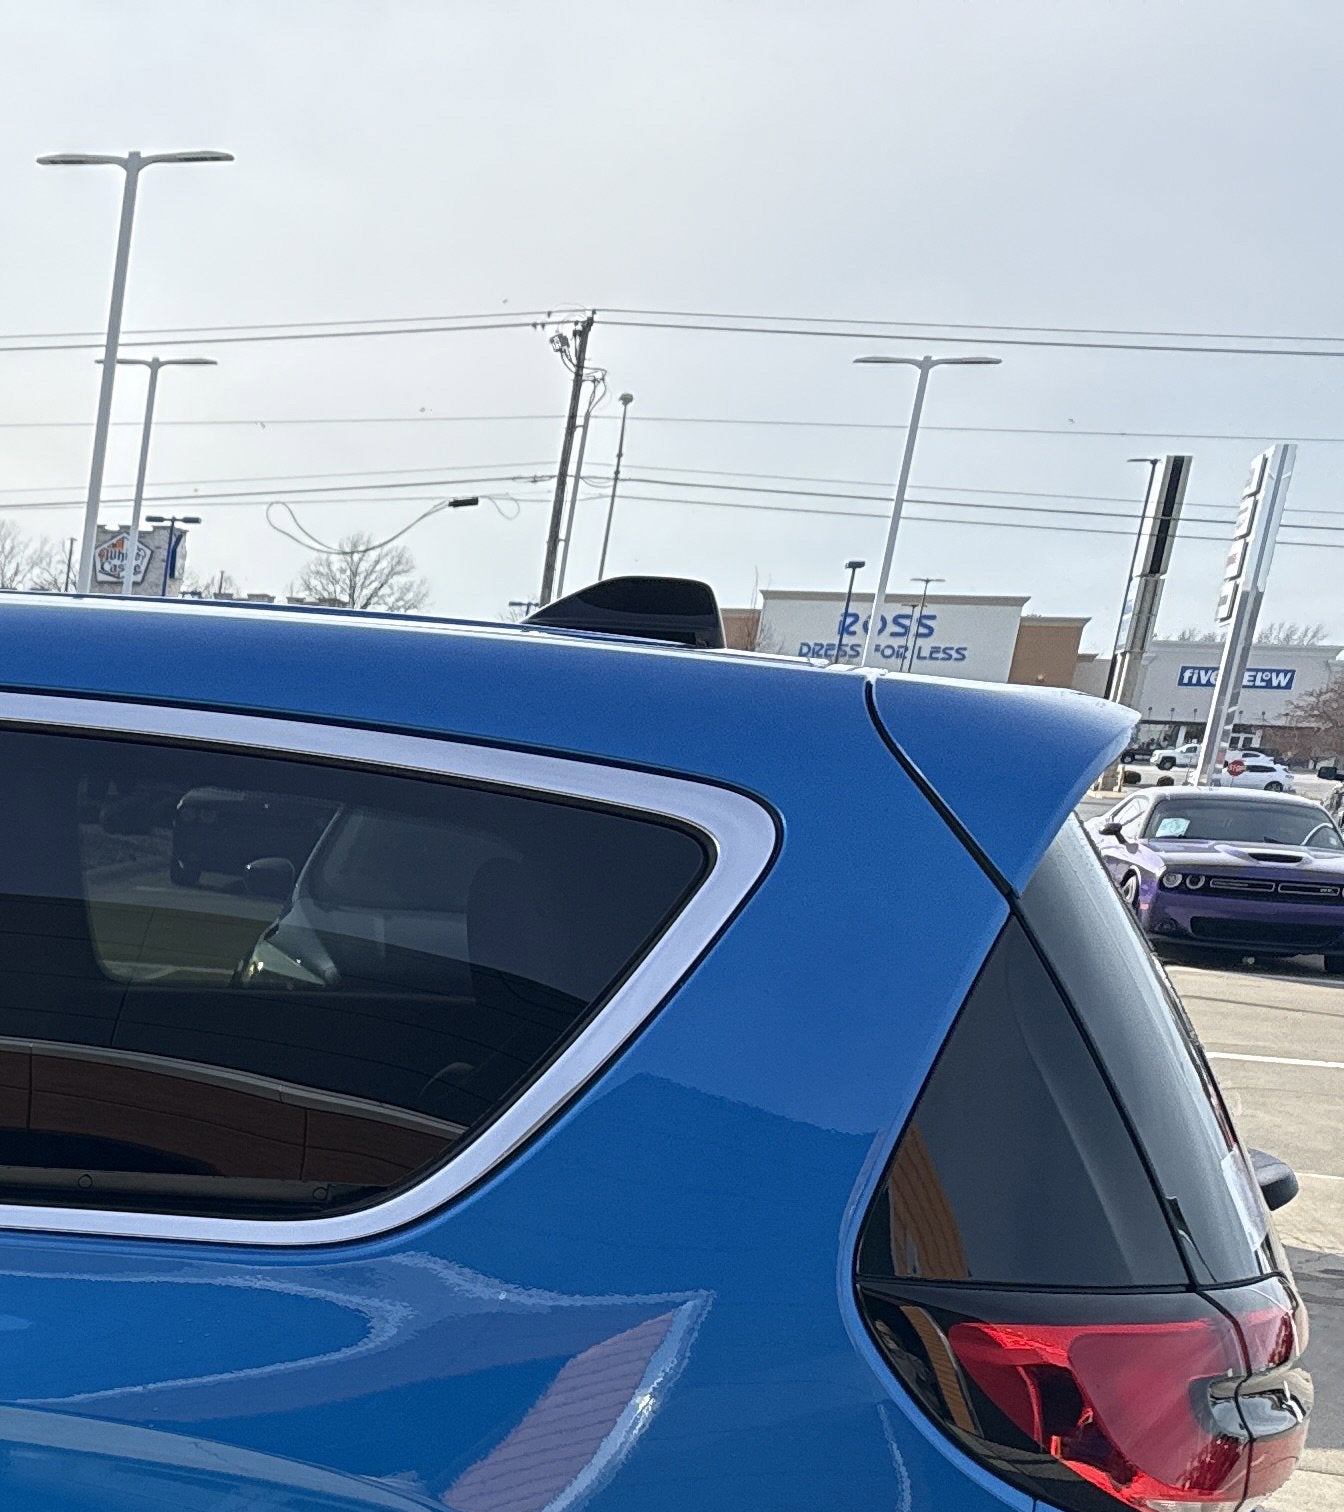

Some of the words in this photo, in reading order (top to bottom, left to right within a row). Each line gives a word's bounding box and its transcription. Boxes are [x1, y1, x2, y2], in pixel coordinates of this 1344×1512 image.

[99, 561, 142, 578] Case
[837, 612, 937, 638] ROSS
[798, 642, 862, 659] DRESS
[916, 646, 968, 662] LESS
